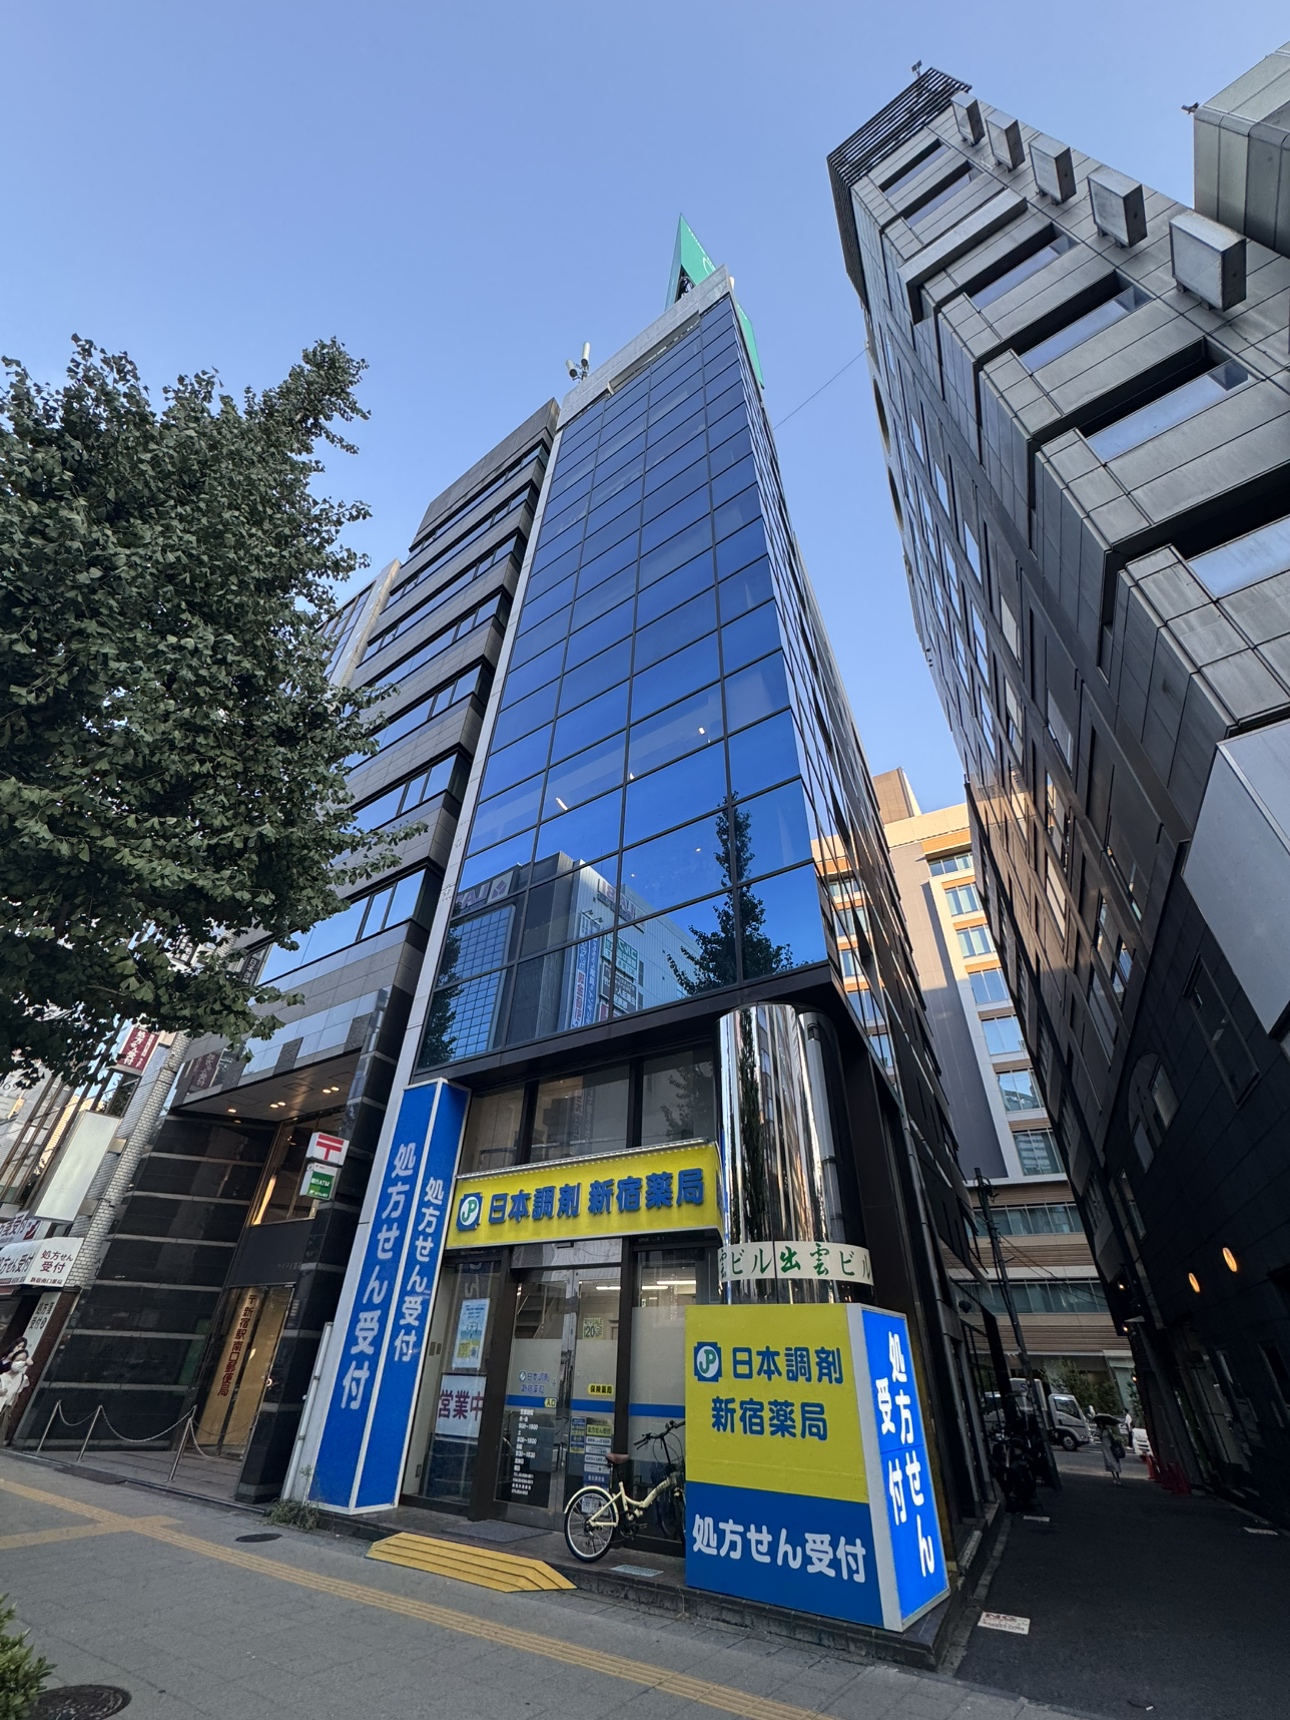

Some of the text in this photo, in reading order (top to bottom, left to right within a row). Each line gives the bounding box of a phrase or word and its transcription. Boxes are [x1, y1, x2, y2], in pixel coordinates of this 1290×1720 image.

[488, 1167, 705, 1224] 日本調剤 新宿薬局
[40, 1249, 73, 1262] 処方せん
[40, 1261, 66, 1273] 受付
[341, 1142, 416, 1410] 処方せん受付
[394, 1177, 444, 1363] 処方せん受付
[732, 1345, 843, 1385] 日本調剤
[438, 1388, 484, 1420] 営業中
[711, 1396, 828, 1442] 新宿薬局
[876, 1378, 907, 1526] 受付
[886, 1331, 936, 1578] 処方せん
[692, 1514, 866, 1584] 処方せん受付
